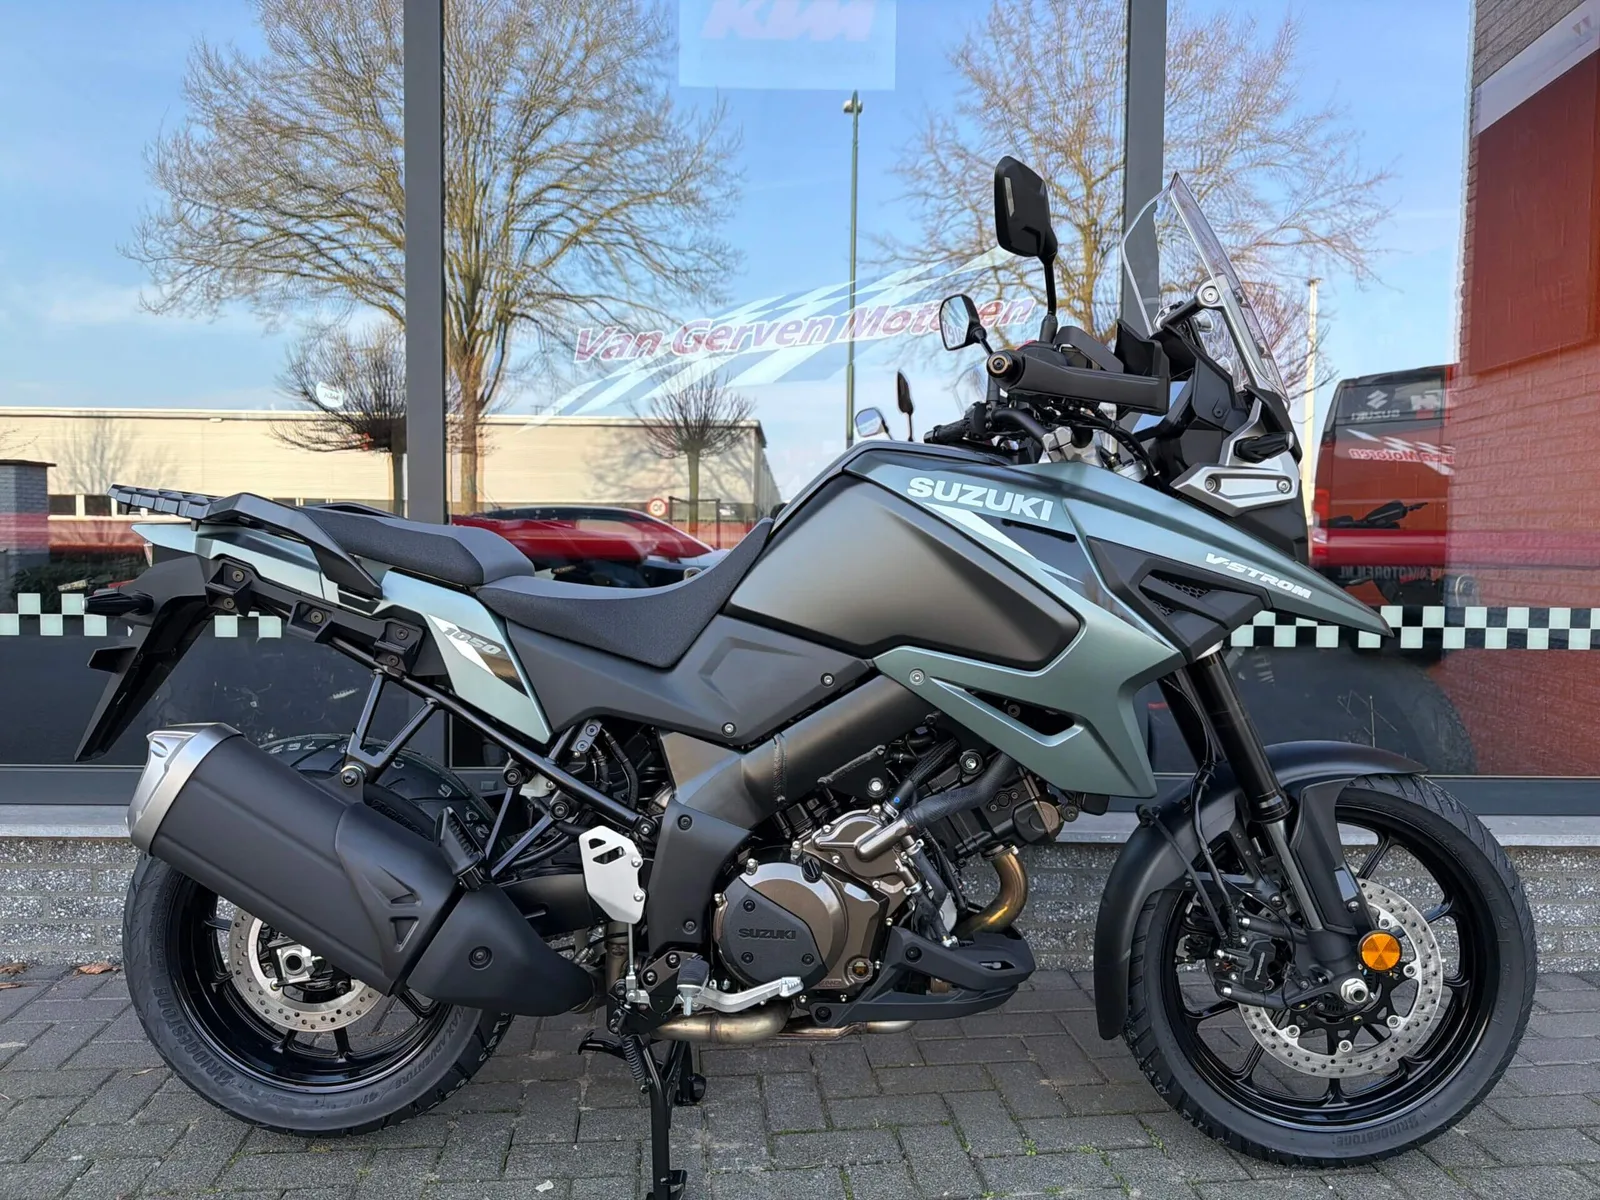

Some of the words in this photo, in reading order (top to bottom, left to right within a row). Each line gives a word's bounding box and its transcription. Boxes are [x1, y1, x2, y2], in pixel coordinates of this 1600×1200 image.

[574, 326, 665, 363] Van
[671, 315, 838, 356] Gerven
[838, 296, 1037, 343] Motoen
[907, 477, 1054, 522] SUZUKI
[1205, 552, 1312, 599] V-STROM
[444, 626, 502, 655] 1050
[738, 928, 796, 940] SUZUKI
[153, 987, 236, 1088] BRIDGESTONE
